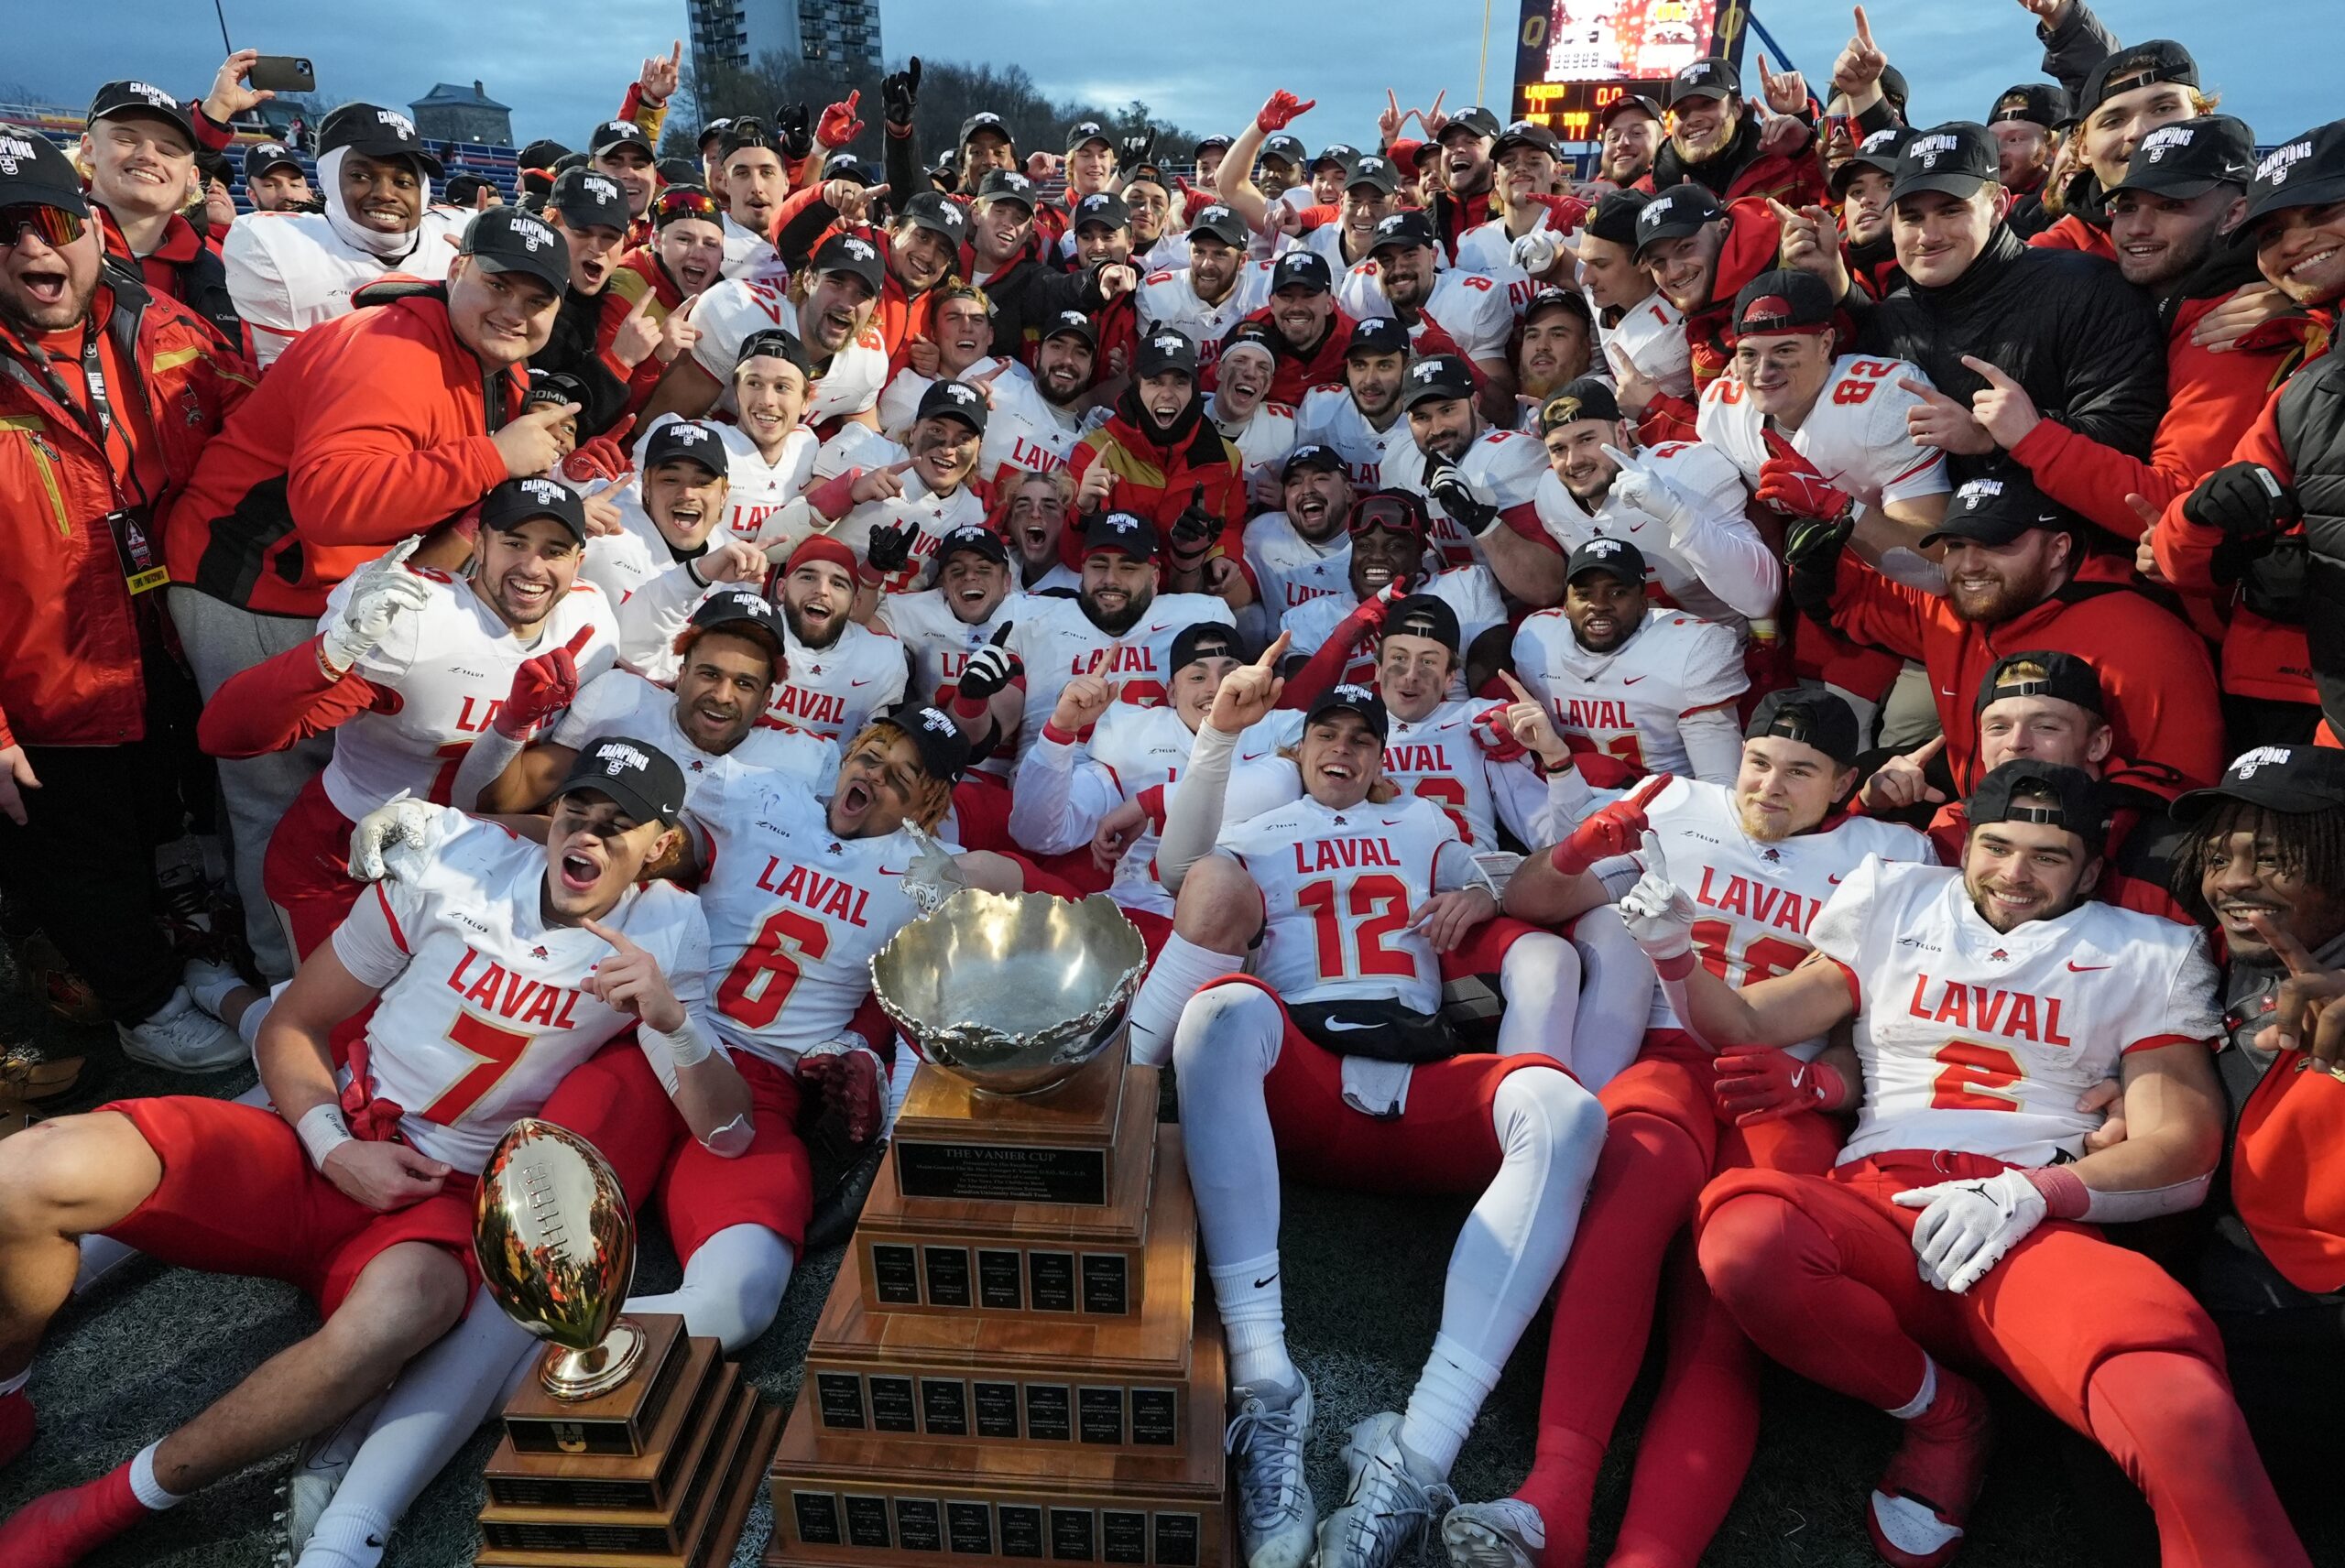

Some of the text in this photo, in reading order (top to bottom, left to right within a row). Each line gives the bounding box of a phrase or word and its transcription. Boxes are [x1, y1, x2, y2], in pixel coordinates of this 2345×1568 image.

[1522, 15, 1547, 49] Q
[130, 82, 177, 110] CHAMPIONS
[1910, 134, 1958, 158] CHAMPIONS
[2141, 128, 2194, 152] CHAMPIONS
[2254, 141, 2312, 182] CHAMPIONS
[510, 218, 554, 247] CHAMPIONS
[670, 425, 709, 442] CHAMPIONS
[520, 478, 567, 503] CHAMPIONS
[1957, 480, 2004, 499] CHAMPIONS
[733, 593, 772, 617] CHAMPIONS
[919, 707, 957, 738] CHAMPIONS
[1554, 697, 1636, 730] LAVAL
[595, 744, 649, 772] CHAMPIONS
[1381, 744, 1453, 773] AVAL
[769, 824, 791, 839] TELUS
[1696, 833, 1720, 844] TELUS
[1292, 837, 1401, 875] LAVAL
[756, 855, 870, 929] LAVAL
[462, 916, 489, 934] TELUS
[1292, 873, 1421, 983] 12
[1915, 942, 1943, 953] TELUS
[713, 906, 834, 1031] 6
[446, 945, 585, 1031] LAVAL
[1908, 973, 2072, 1048] LAVAL
[417, 1005, 539, 1128] 7
[1928, 1035, 2030, 1113] 2
[944, 1149, 1056, 1163] THE VANIER CUP
